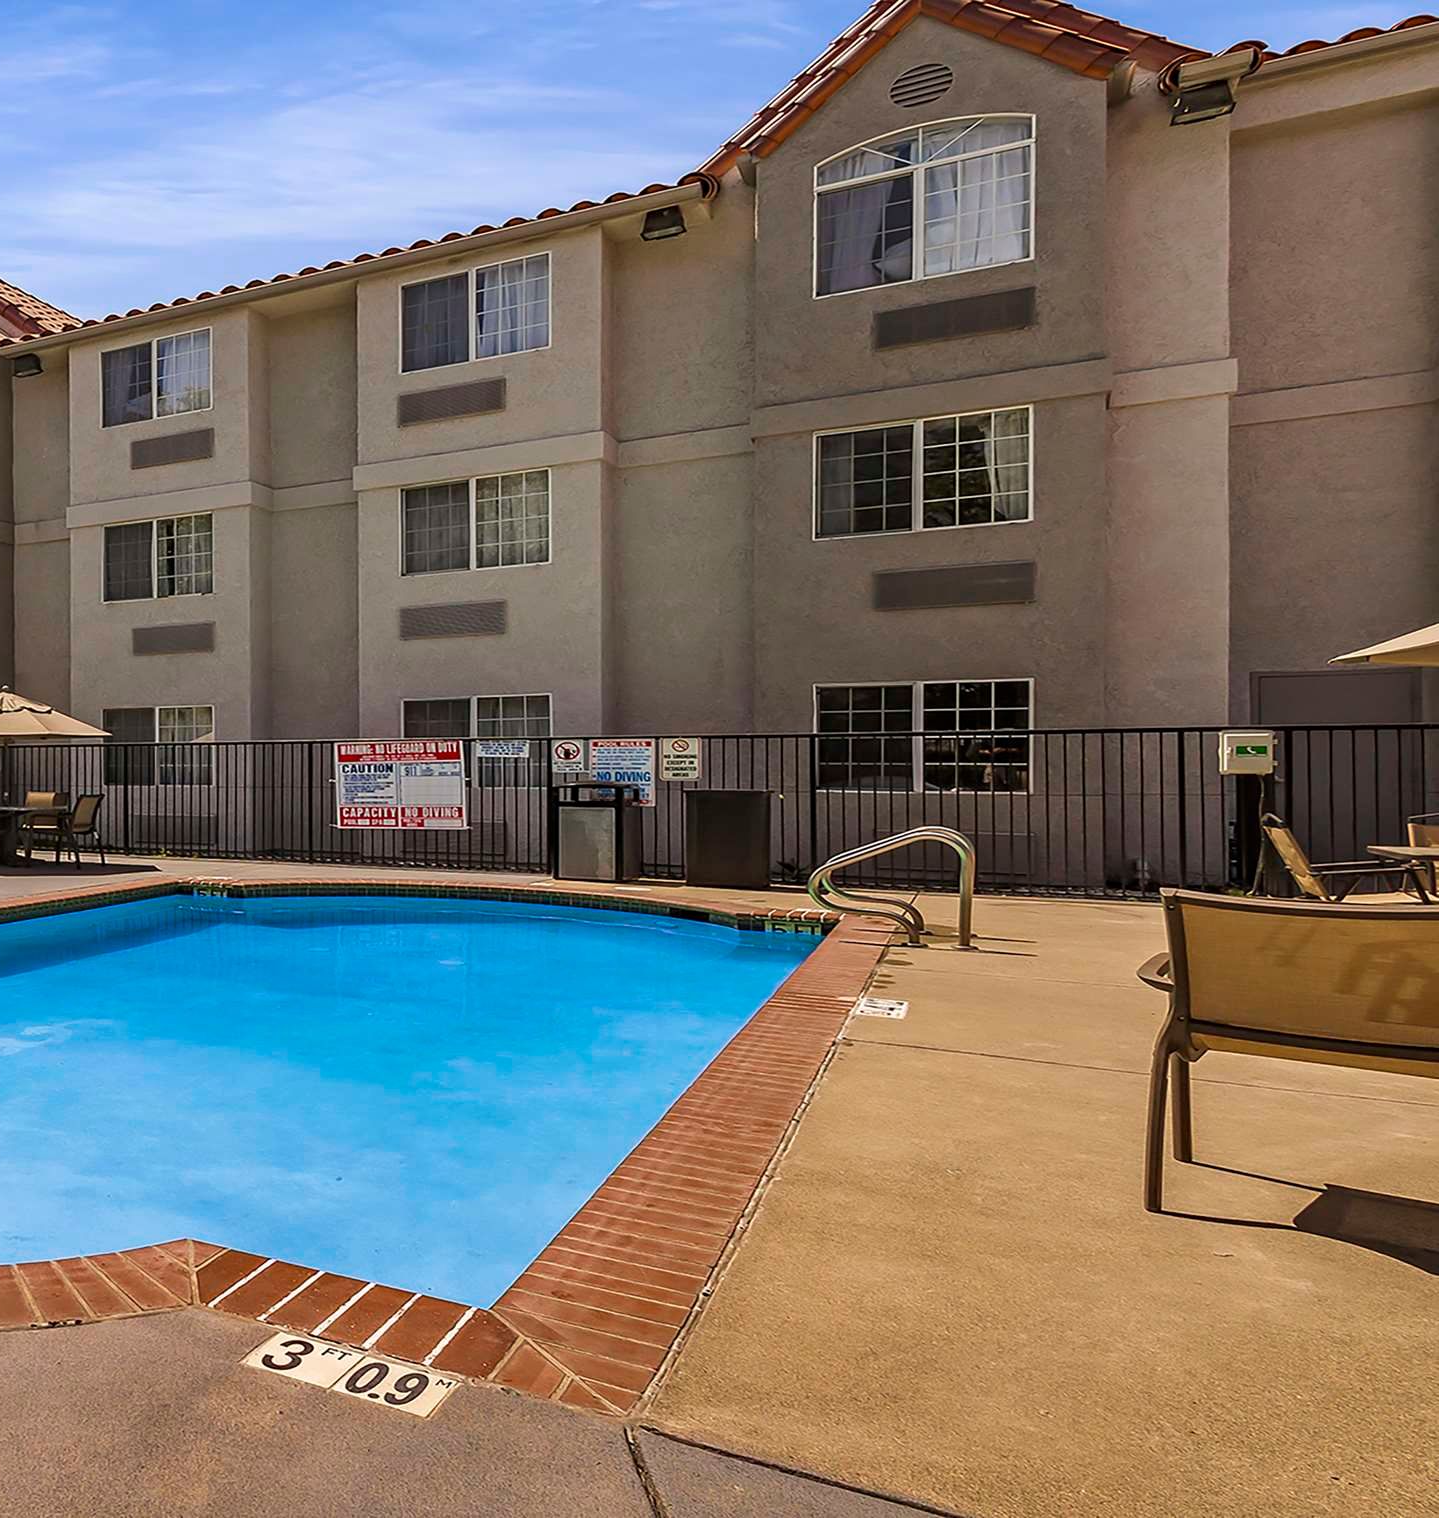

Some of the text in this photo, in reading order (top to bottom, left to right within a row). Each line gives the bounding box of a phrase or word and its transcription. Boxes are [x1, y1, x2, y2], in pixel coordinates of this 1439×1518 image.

[375, 743, 385, 754] NO
[386, 743, 424, 754] LIFEGUARD
[426, 742, 436, 753] ON
[438, 742, 457, 753] DUTY
[342, 764, 394, 773] CAUTION
[597, 772, 651, 782] NO DIVING
[342, 807, 396, 818] CAPACITY
[404, 807, 459, 818] NO DIVING
[261, 1339, 353, 1371] 3 FT
[345, 1362, 453, 1406] 0.9 M
